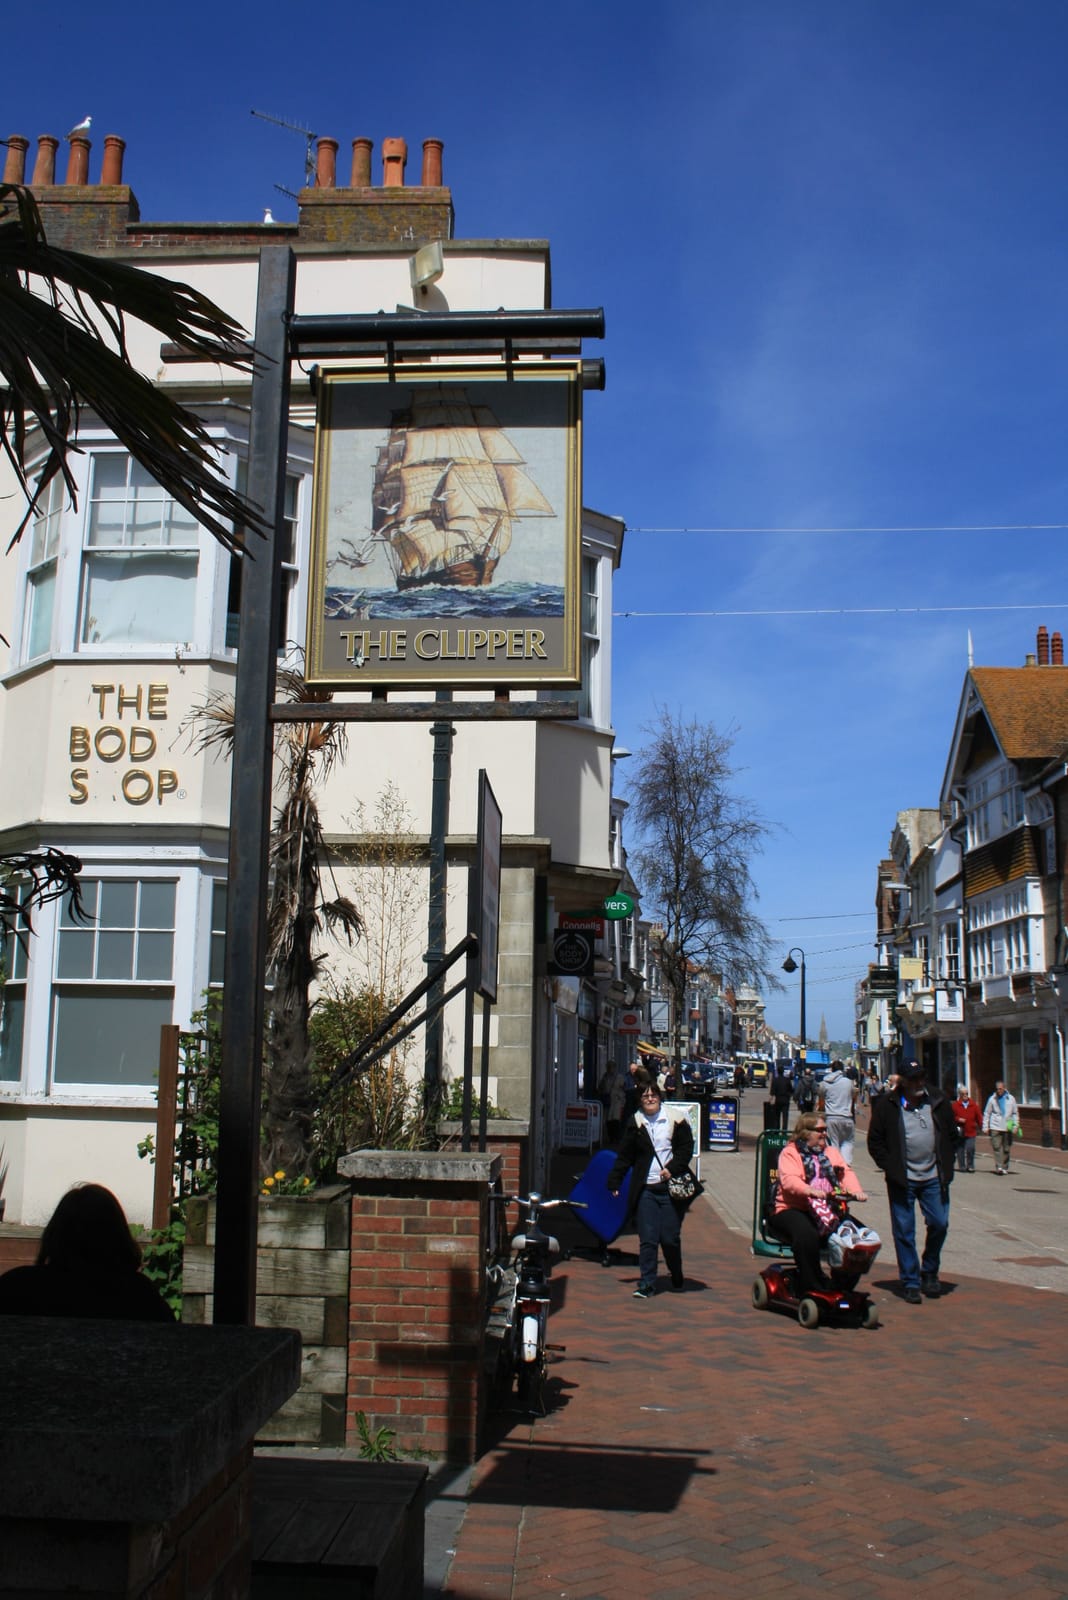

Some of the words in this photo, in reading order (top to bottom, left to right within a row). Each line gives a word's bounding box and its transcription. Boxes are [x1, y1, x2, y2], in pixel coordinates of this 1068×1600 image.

[340, 630, 407, 660] THE
[413, 629, 548, 660] CLIPPER
[92, 684, 169, 720] THE
